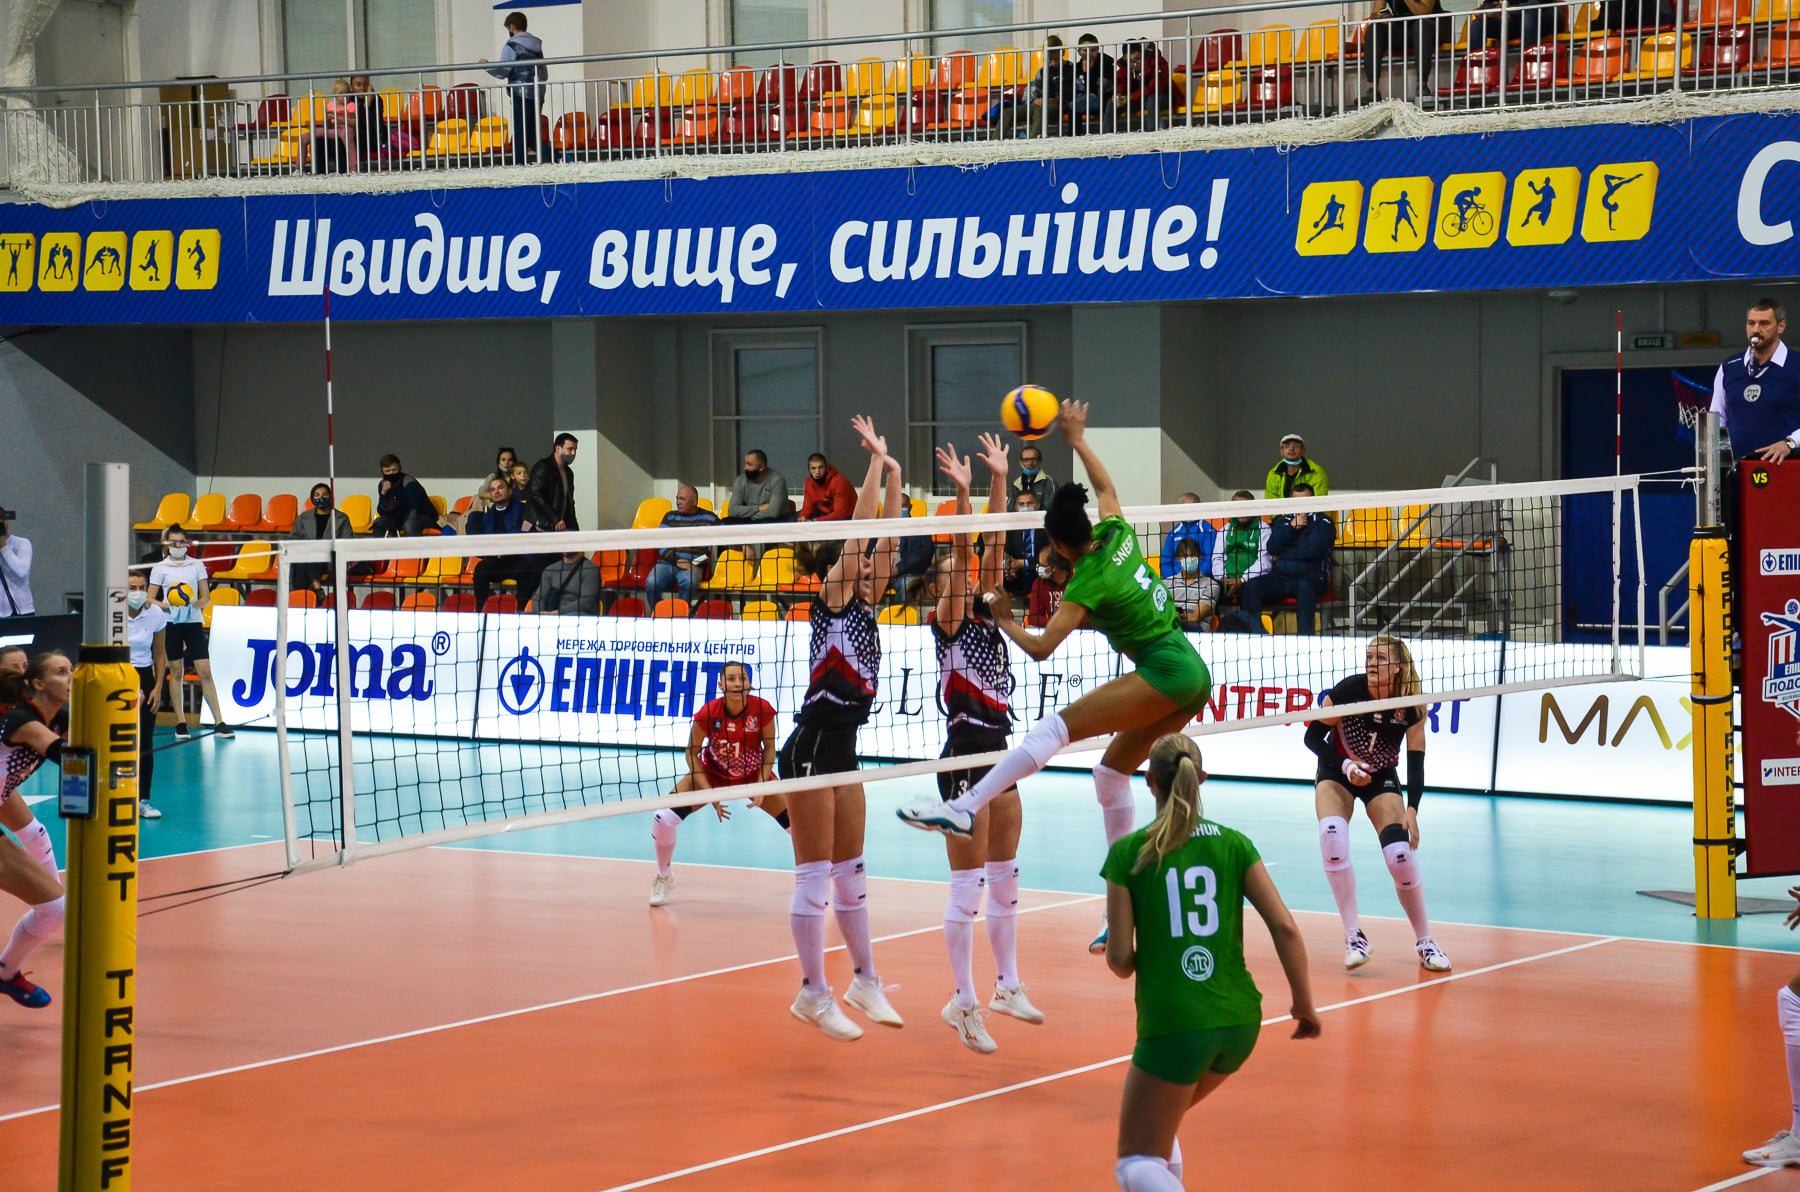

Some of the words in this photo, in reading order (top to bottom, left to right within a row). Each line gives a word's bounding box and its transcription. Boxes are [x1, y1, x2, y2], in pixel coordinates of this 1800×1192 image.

[268, 212, 561, 304] Швидше,
[589, 223, 798, 303] вище,
[830, 178, 1230, 283] сильніше!
[1752, 472, 1768, 484] VS
[1778, 554, 1800, 571] ЕПІ
[112, 611, 124, 645] SP
[556, 638, 606, 651] МЕРЕЖА
[609, 640, 701, 654] ТОРГОВЕЛЬНИХ
[703, 643, 755, 656] ЦЕНТРІВ
[551, 656, 753, 721] ЕПІЦЕНТ
[1784, 662, 1800, 676] ЕПІ
[107, 723, 137, 901] SPORT
[1165, 866, 1219, 938] 13
[101, 969, 134, 1190] TRANSF
